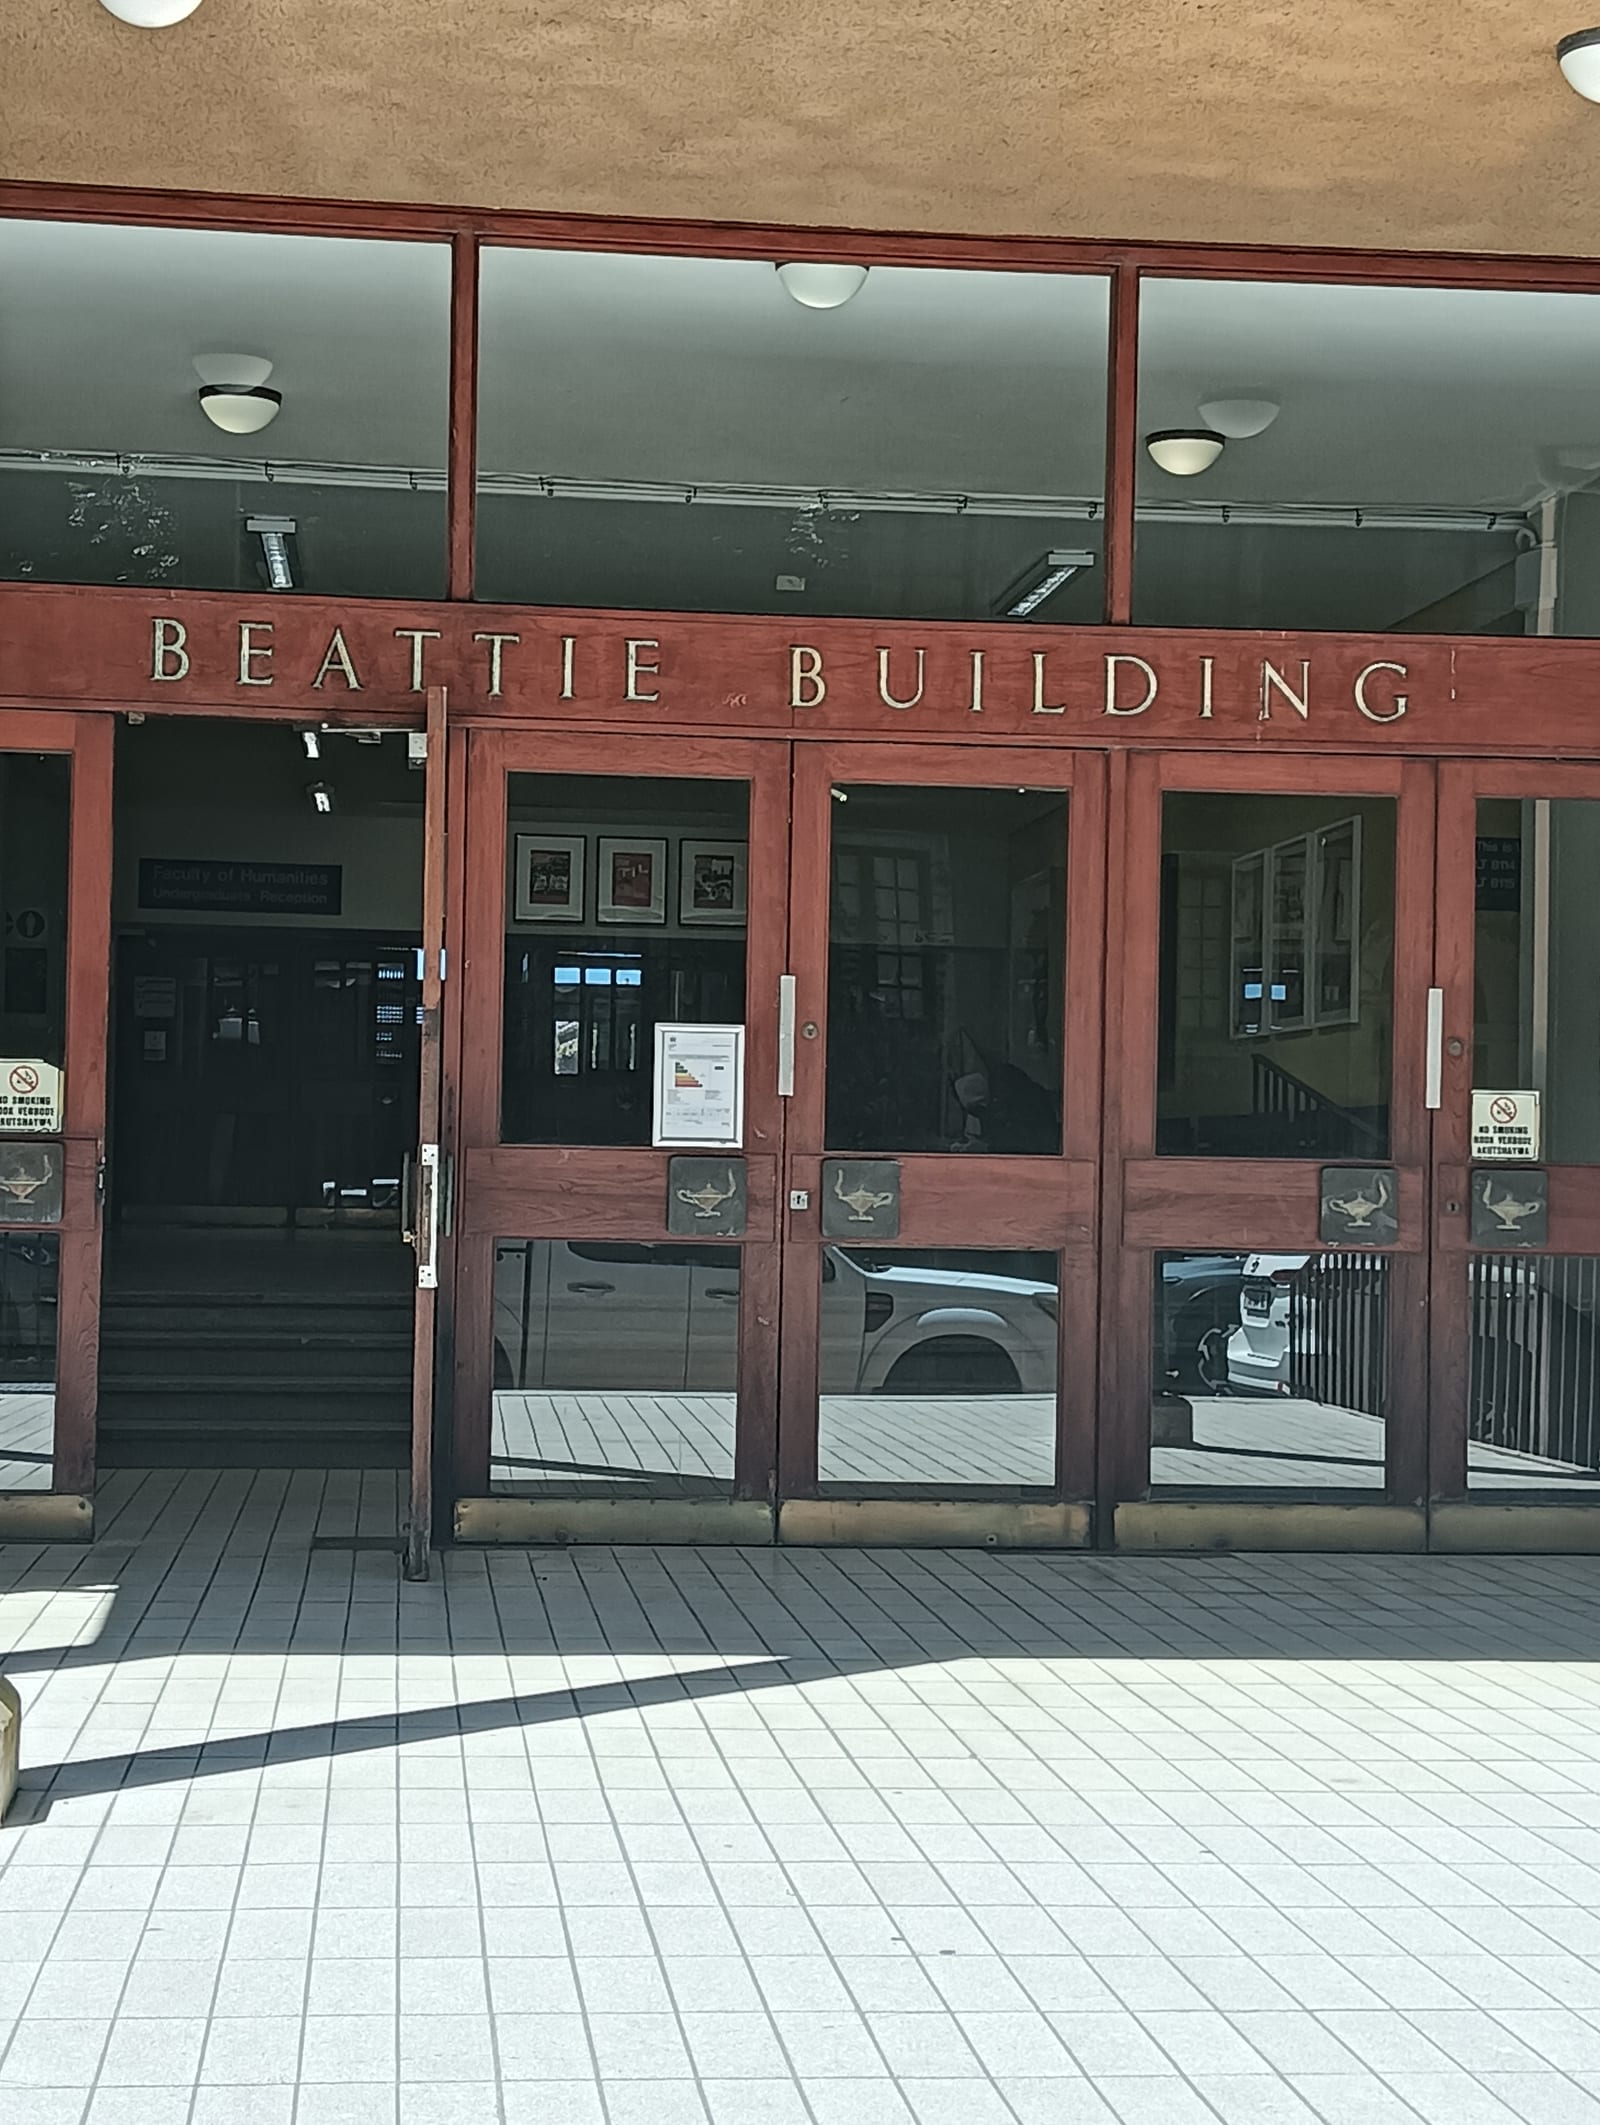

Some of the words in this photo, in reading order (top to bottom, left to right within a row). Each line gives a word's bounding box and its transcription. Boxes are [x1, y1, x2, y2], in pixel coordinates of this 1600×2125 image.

[150, 616, 661, 702] BEATTIE
[788, 644, 1409, 723] BUILDING
[152, 865, 210, 884] Faculty
[217, 866, 234, 882] of
[240, 868, 329, 886] Humanities
[259, 890, 328, 906] Reception
[12, 1096, 51, 1106] SMOKING
[1479, 1126, 1489, 1134] NO
[1492, 1125, 1529, 1135] SMOKING
